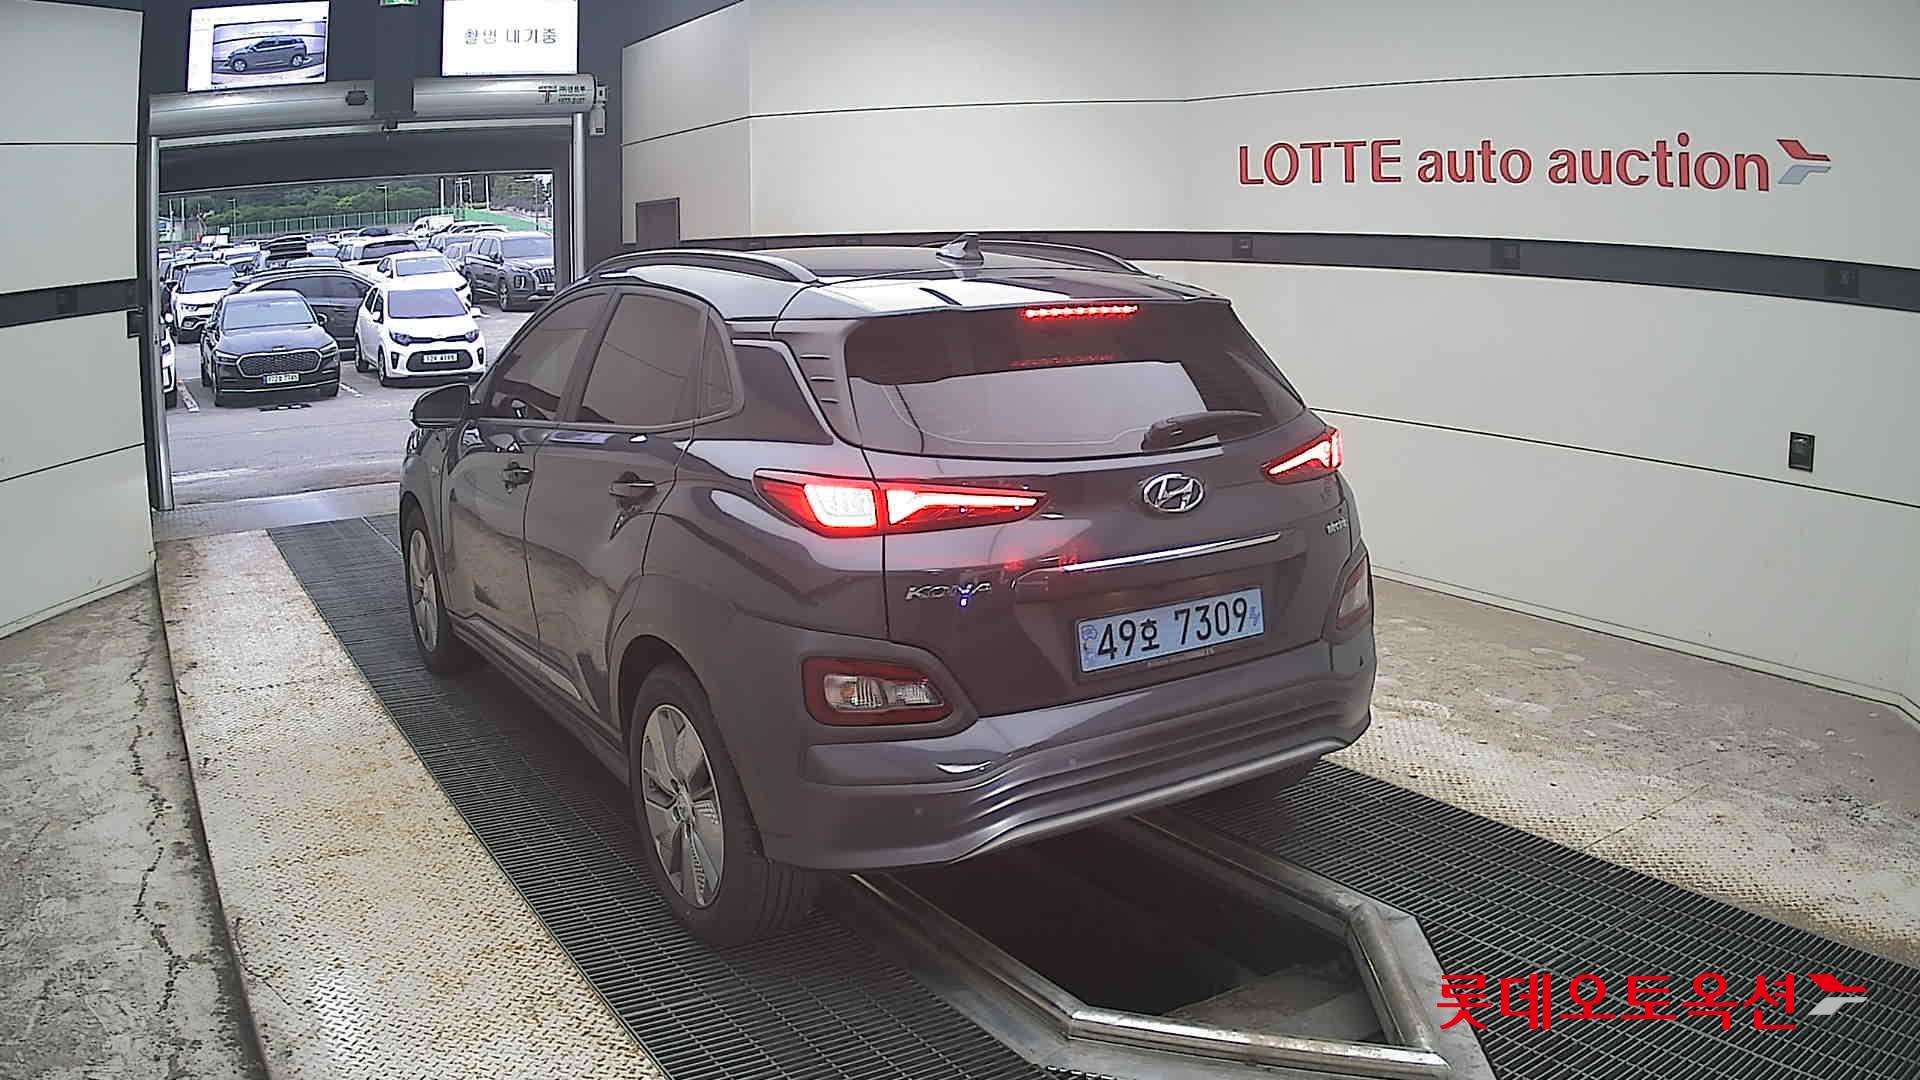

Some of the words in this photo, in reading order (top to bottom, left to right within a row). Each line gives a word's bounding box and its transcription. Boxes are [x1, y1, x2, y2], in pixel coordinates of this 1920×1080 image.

[1239, 139, 1402, 186] LOTTE
[1417, 140, 1532, 184] auto
[1548, 133, 1769, 191] auction
[1097, 618, 1160, 660] 49호
[1174, 597, 1248, 646] 7309
